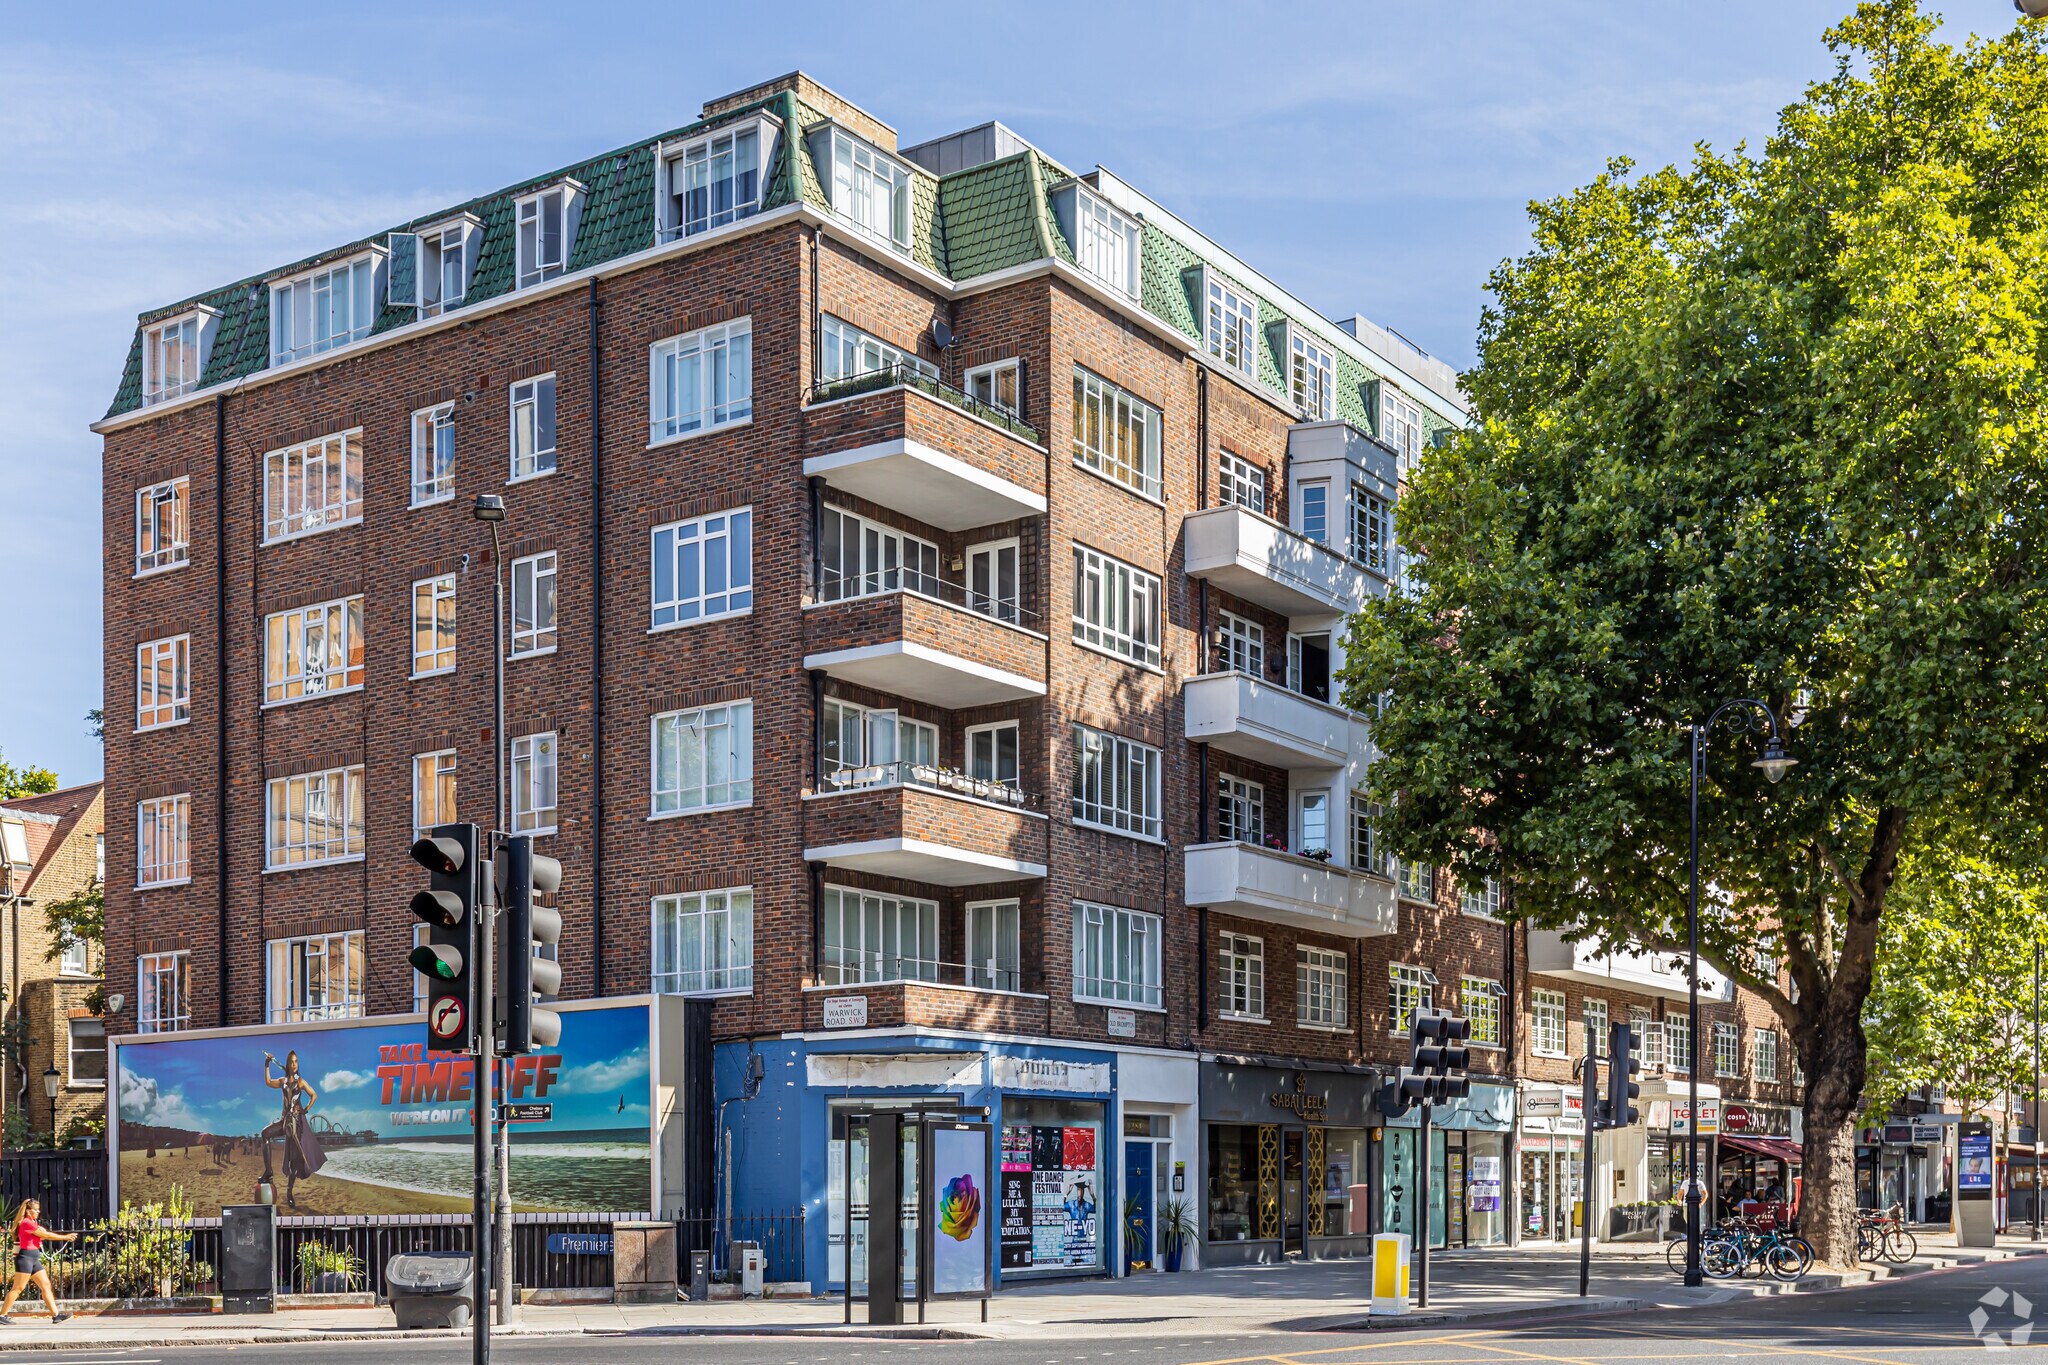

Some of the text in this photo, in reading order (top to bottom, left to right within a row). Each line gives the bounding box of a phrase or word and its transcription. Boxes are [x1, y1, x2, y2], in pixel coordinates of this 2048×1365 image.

[828, 1008, 862, 1017] WARWICK
[379, 1044, 422, 1063] TAKE
[377, 1060, 474, 1105] TIME
[1272, 1092, 1328, 1109] SABAI LEELA
[390, 1110, 430, 1126] WE'RE
[430, 1109, 450, 1124] ON
[452, 1108, 466, 1123] IT
[1032, 1172, 1064, 1182] ONE DANCE
[1684, 1165, 1703, 1177] GSS
[1035, 1183, 1062, 1193] FESTIVAL
[1011, 1208, 1019, 1216] MY
[1006, 1218, 1024, 1226] SWEET
[1064, 1220, 1096, 1236] NE-YO
